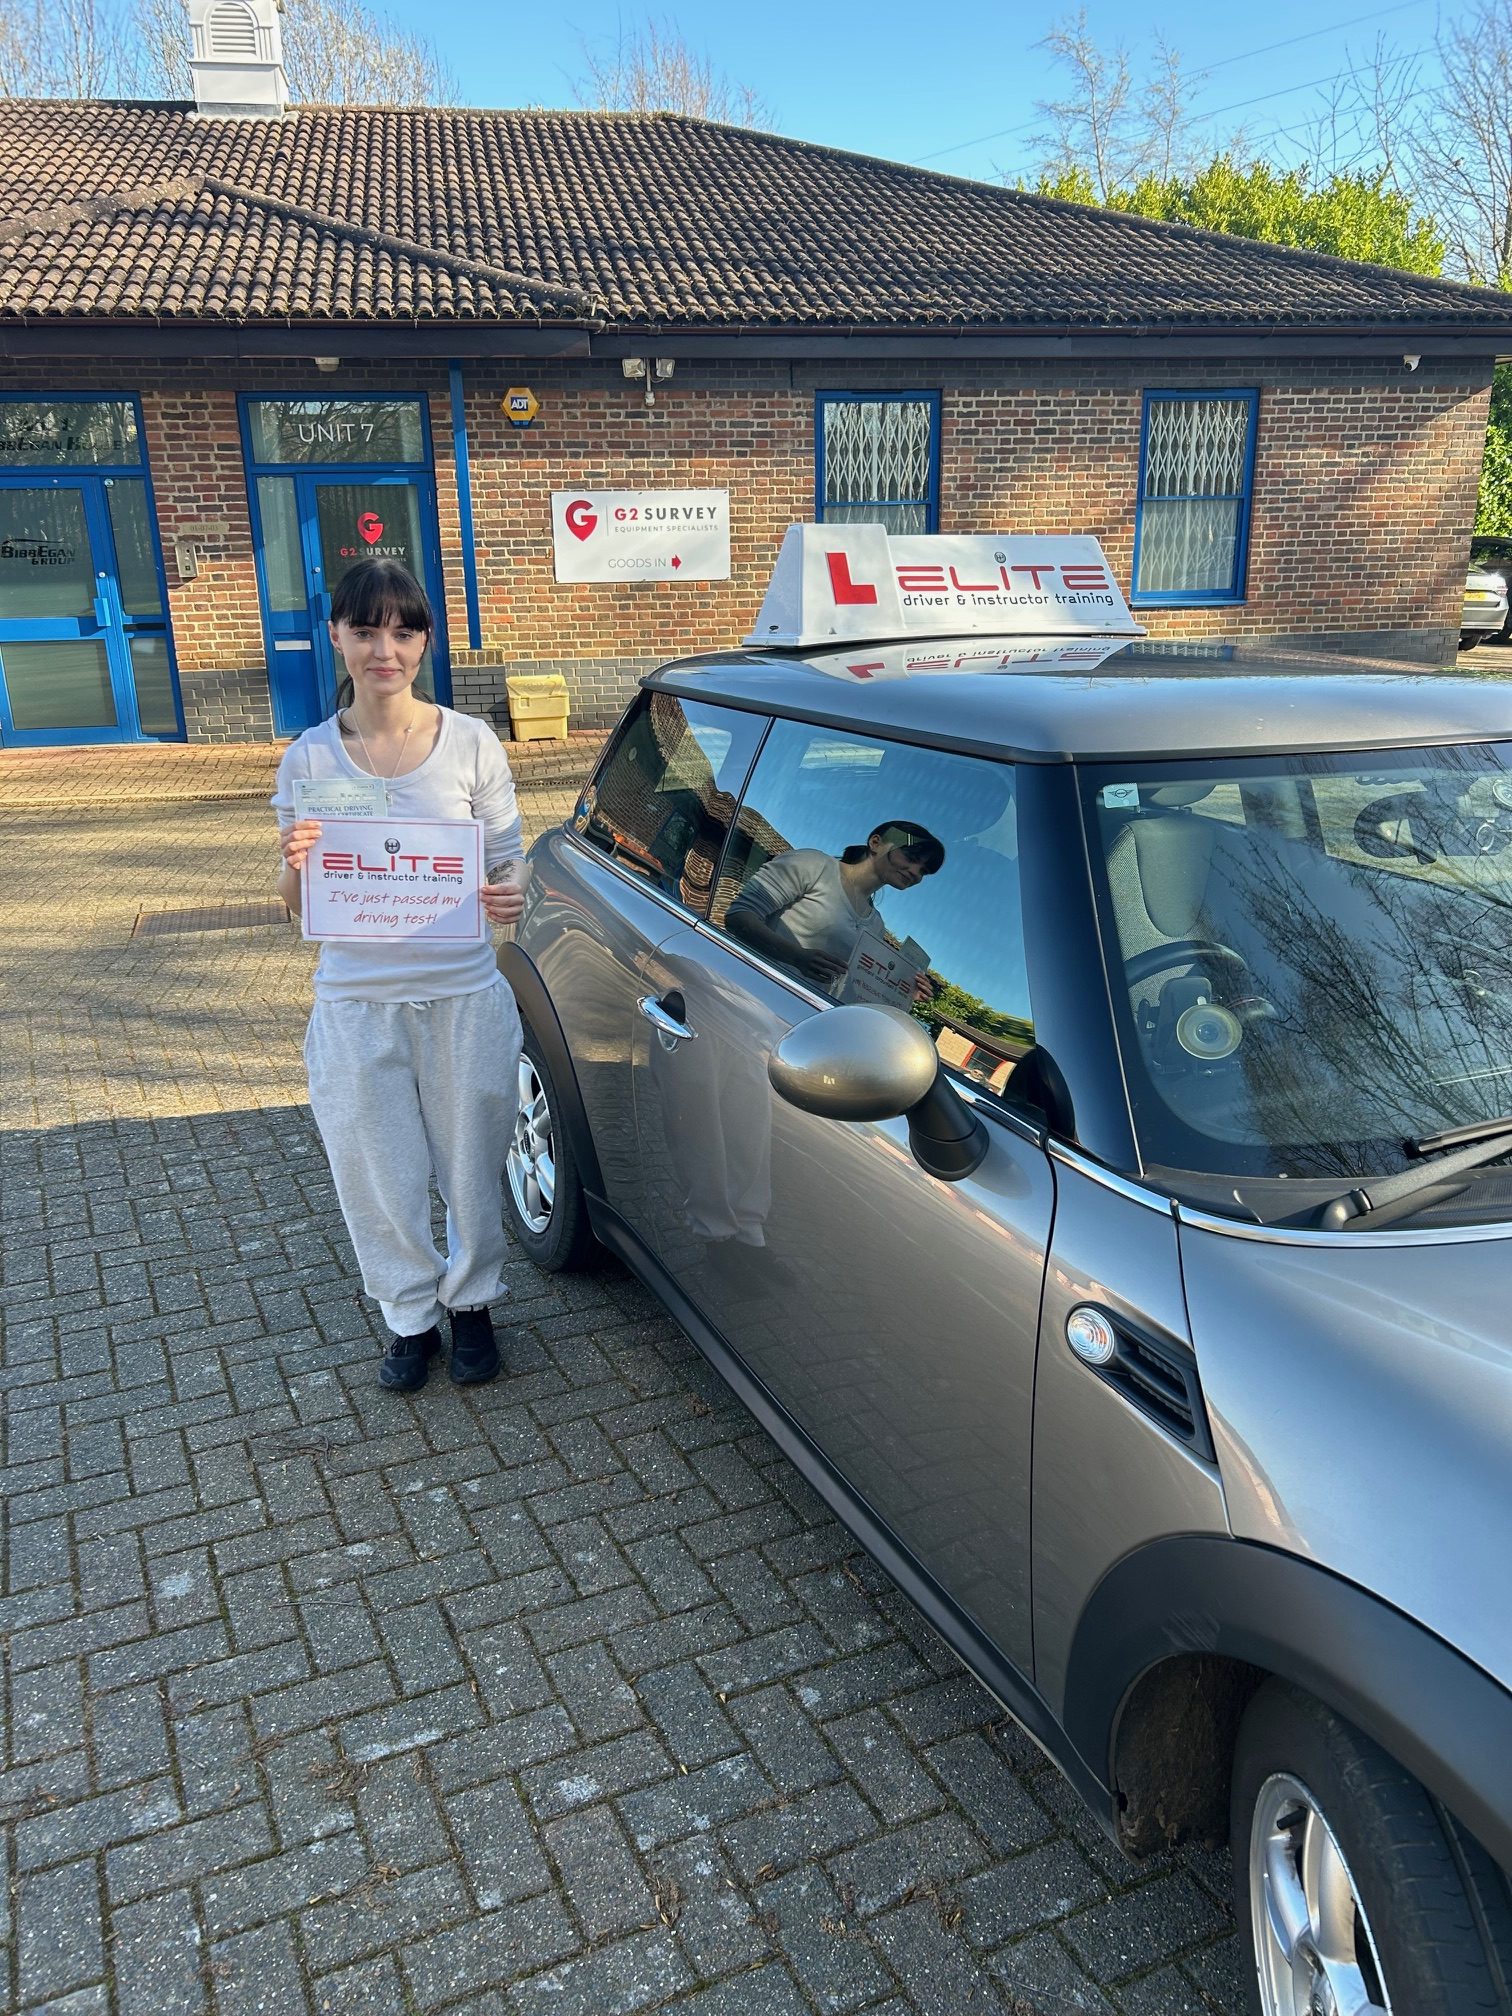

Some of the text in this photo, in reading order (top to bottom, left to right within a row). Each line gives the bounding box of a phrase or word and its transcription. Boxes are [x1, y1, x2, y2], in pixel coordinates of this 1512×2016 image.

[511, 399, 528, 410] ADT
[299, 423, 374, 442] UNIT 7
[614, 507, 717, 521] G2 SURVEY
[614, 524, 718, 533] EQUIPMENT SPECIALISTS
[340, 547, 406, 557] G2 SURVEY
[608, 557, 667, 568] GOODS IN
[825, 552, 878, 605] L
[895, 565, 1110, 592] ELITE
[903, 592, 1115, 607] driver & instructor training
[308, 804, 373, 813] PRACTICAL DRIVING
[322, 852, 464, 874] ELITE
[323, 871, 463, 885] driver & instructor training
[328, 890, 462, 908] I've just passed my
[353, 911, 438, 928] driving test!
